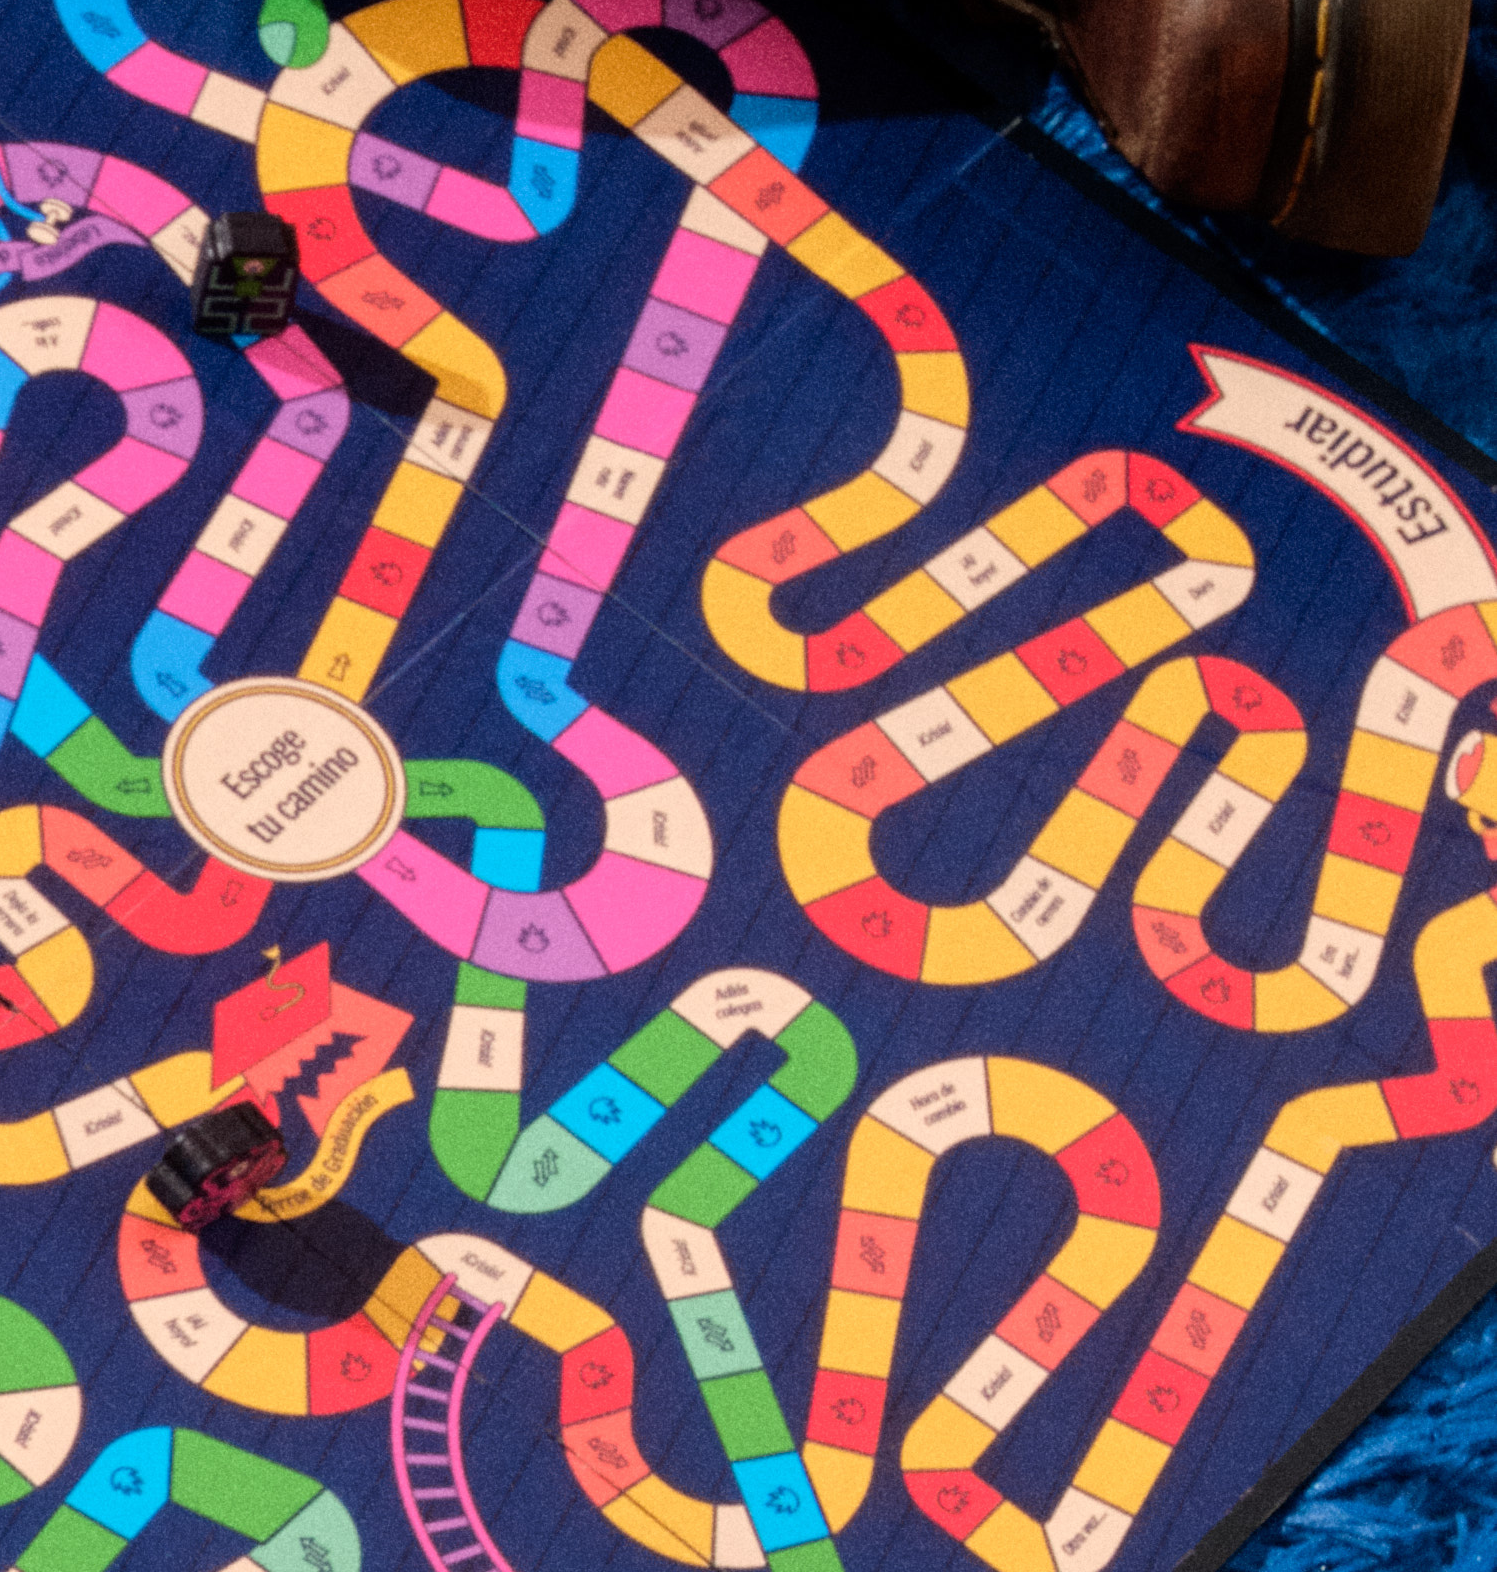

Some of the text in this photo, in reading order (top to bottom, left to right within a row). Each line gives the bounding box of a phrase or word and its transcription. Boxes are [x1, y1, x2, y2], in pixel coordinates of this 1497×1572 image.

[1285, 406, 1450, 546] Estudiar
[219, 729, 307, 801] Escoge
[245, 746, 360, 845] tu camino
[327, 1091, 380, 1173] Graduación
